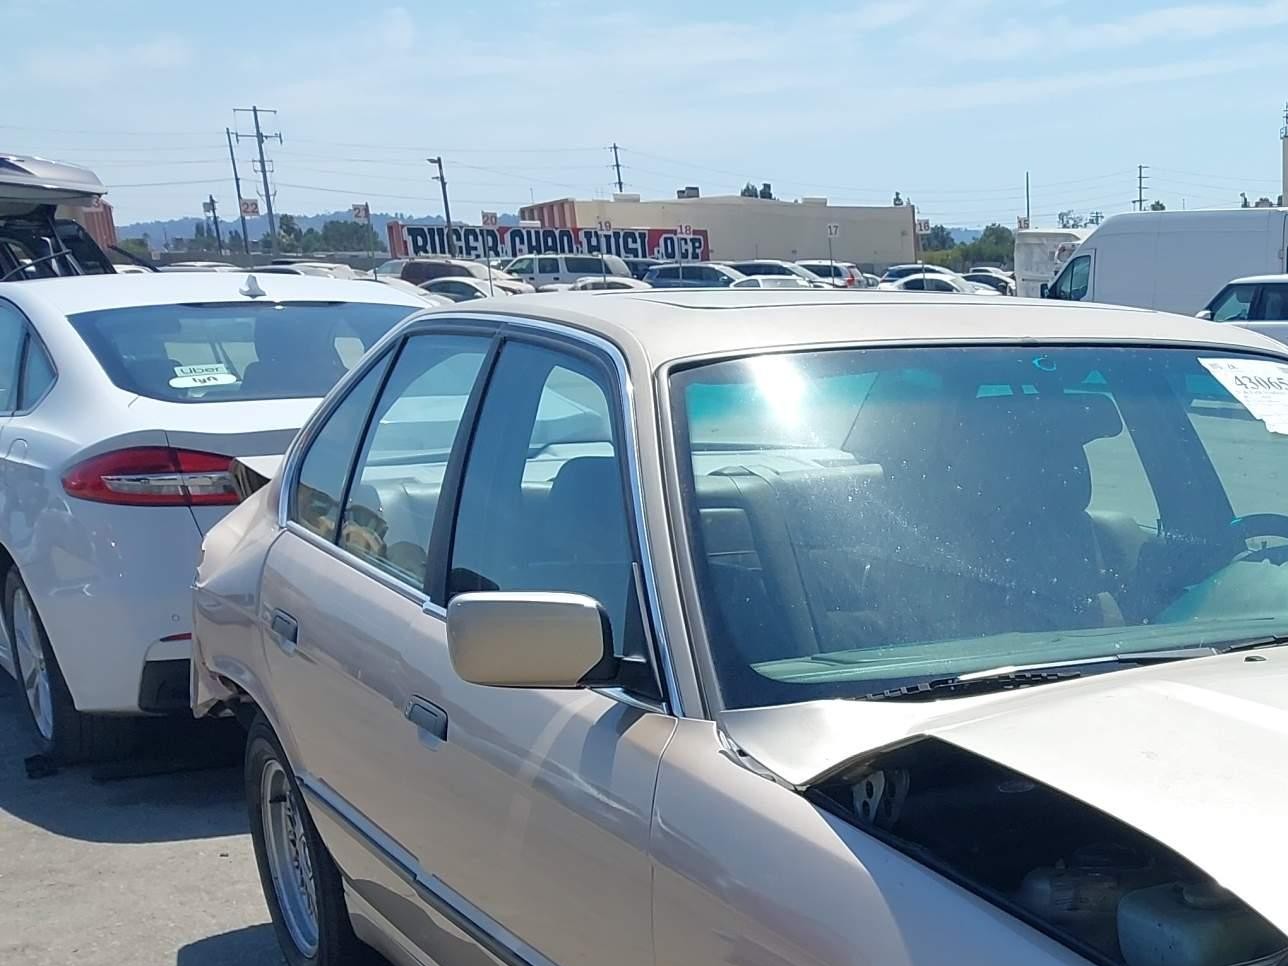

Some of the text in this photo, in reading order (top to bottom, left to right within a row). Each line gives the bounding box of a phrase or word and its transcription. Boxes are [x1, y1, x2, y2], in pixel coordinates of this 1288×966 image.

[242, 201, 258, 214] 22
[353, 206, 368, 219] 21
[482, 214, 497, 226] 20
[598, 220, 612, 231] 19
[1018, 219, 1030, 230] 15
[678, 224, 692, 236] 18
[828, 225, 839, 236] 17
[663, 236, 702, 260] OCP
[180, 366, 220, 375] Uber
